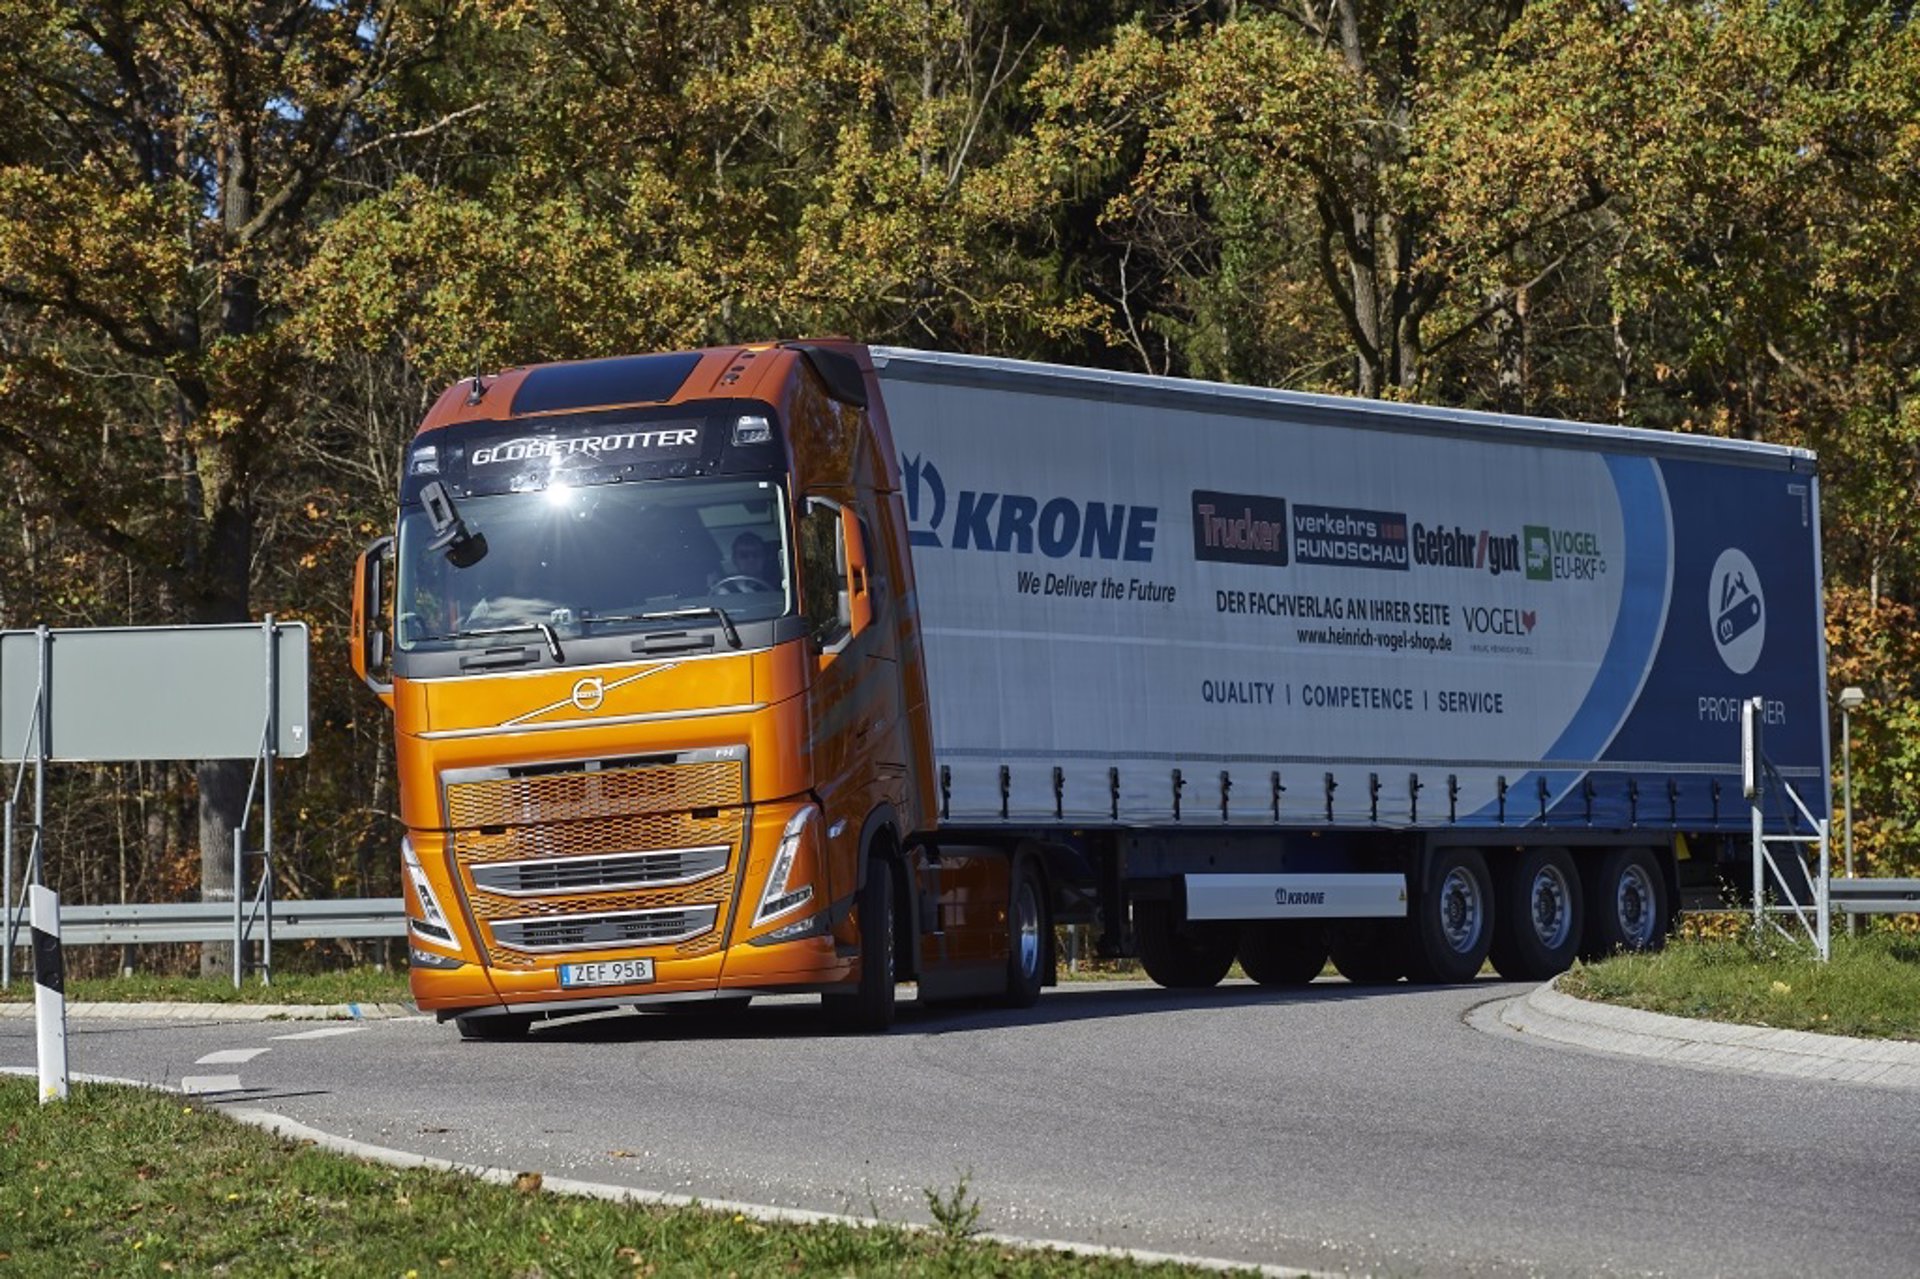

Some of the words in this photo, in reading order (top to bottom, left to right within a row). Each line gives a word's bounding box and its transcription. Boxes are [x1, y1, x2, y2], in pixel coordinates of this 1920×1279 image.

[472, 428, 698, 465] GLOBETROTTER
[952, 490, 1158, 562] KRONE
[1198, 503, 1282, 552] Trucker
[1295, 512, 1377, 538] verkehrs
[1296, 538, 1407, 563] RUNDSCHAU
[1552, 529, 1601, 556] VOGEL
[1017, 571, 1040, 596] We
[1044, 572, 1097, 598] Deliver
[1101, 577, 1124, 600] the
[1128, 578, 1176, 603] Future
[1216, 590, 1247, 614] DER
[1249, 592, 1343, 620] FACHVERLAG
[1347, 597, 1367, 620] AN
[1370, 599, 1411, 623] IHRER
[1413, 602, 1451, 626] SEITE
[1462, 606, 1525, 636] VOGEL
[1297, 626, 1452, 654] www.heinrich-vogel-shop.de
[1202, 679, 1275, 705] QUALITY
[1302, 684, 1413, 710] COMPETENCE
[1438, 690, 1503, 714] SERVICE
[1288, 891, 1325, 905] KRONE
[575, 965, 606, 982] ZEF
[612, 961, 646, 980] 95B
